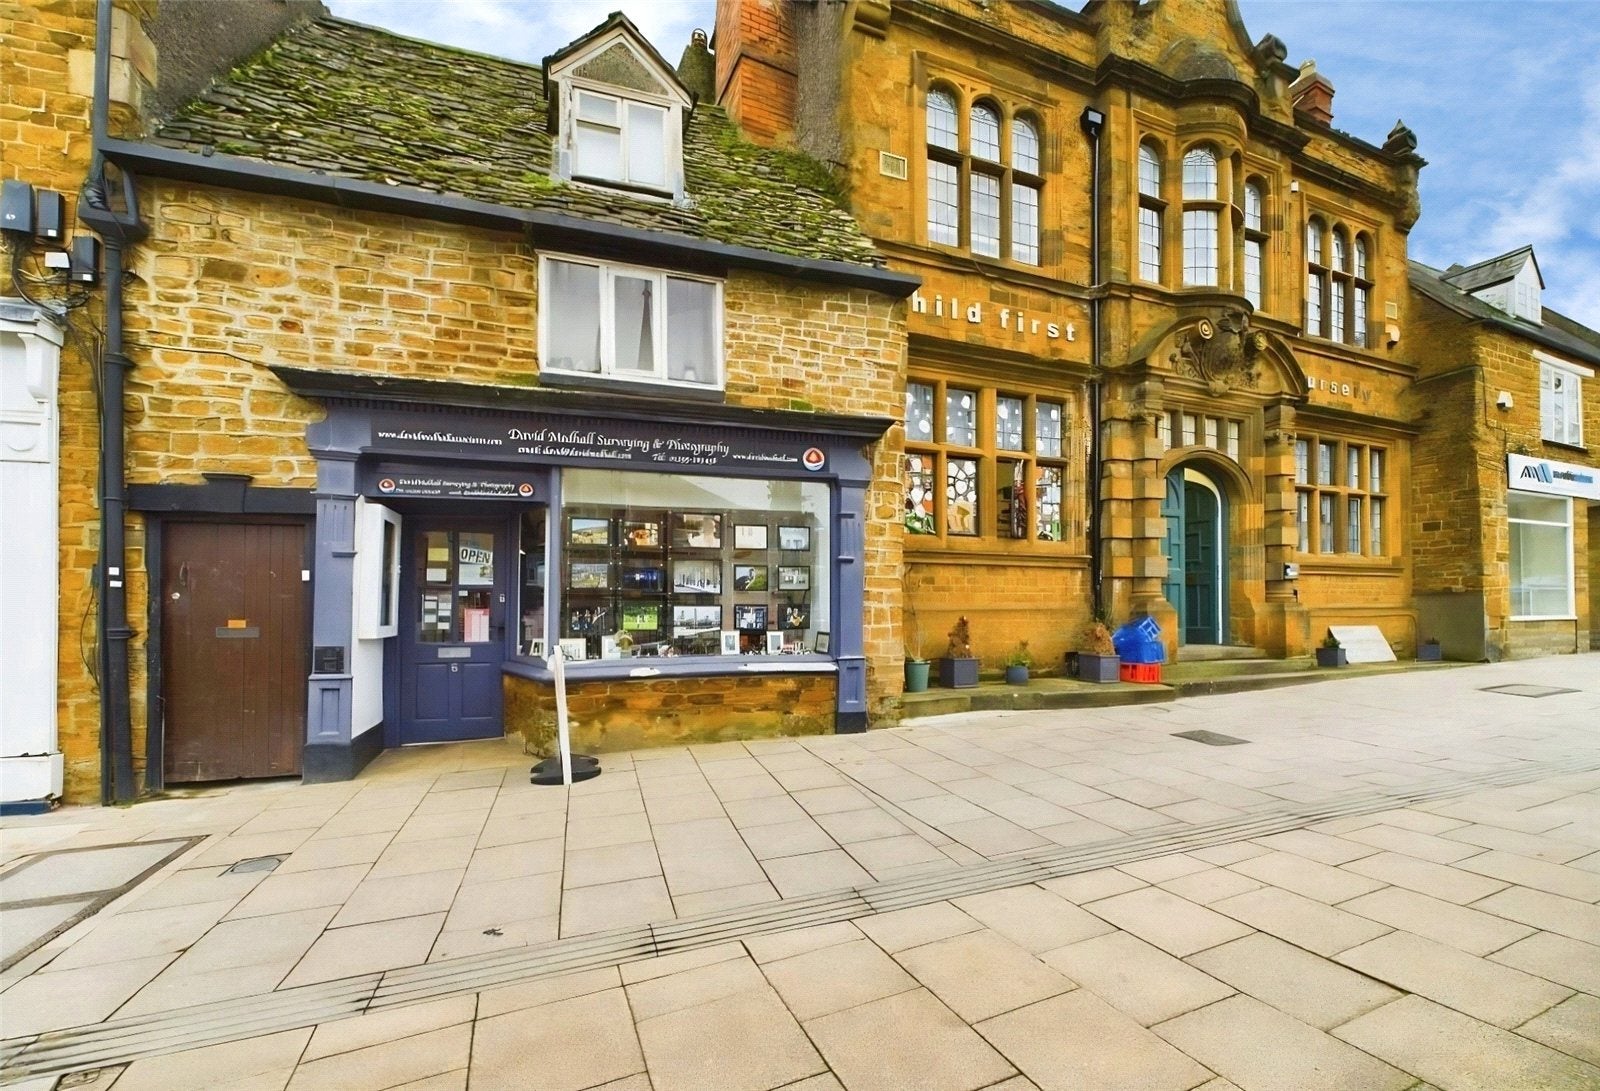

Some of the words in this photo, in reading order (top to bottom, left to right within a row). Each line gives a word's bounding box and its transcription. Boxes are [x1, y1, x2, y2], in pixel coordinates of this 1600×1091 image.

[1000, 308, 1075, 342] first
[508, 428, 547, 441] David
[460, 548, 491, 564] OPEN
